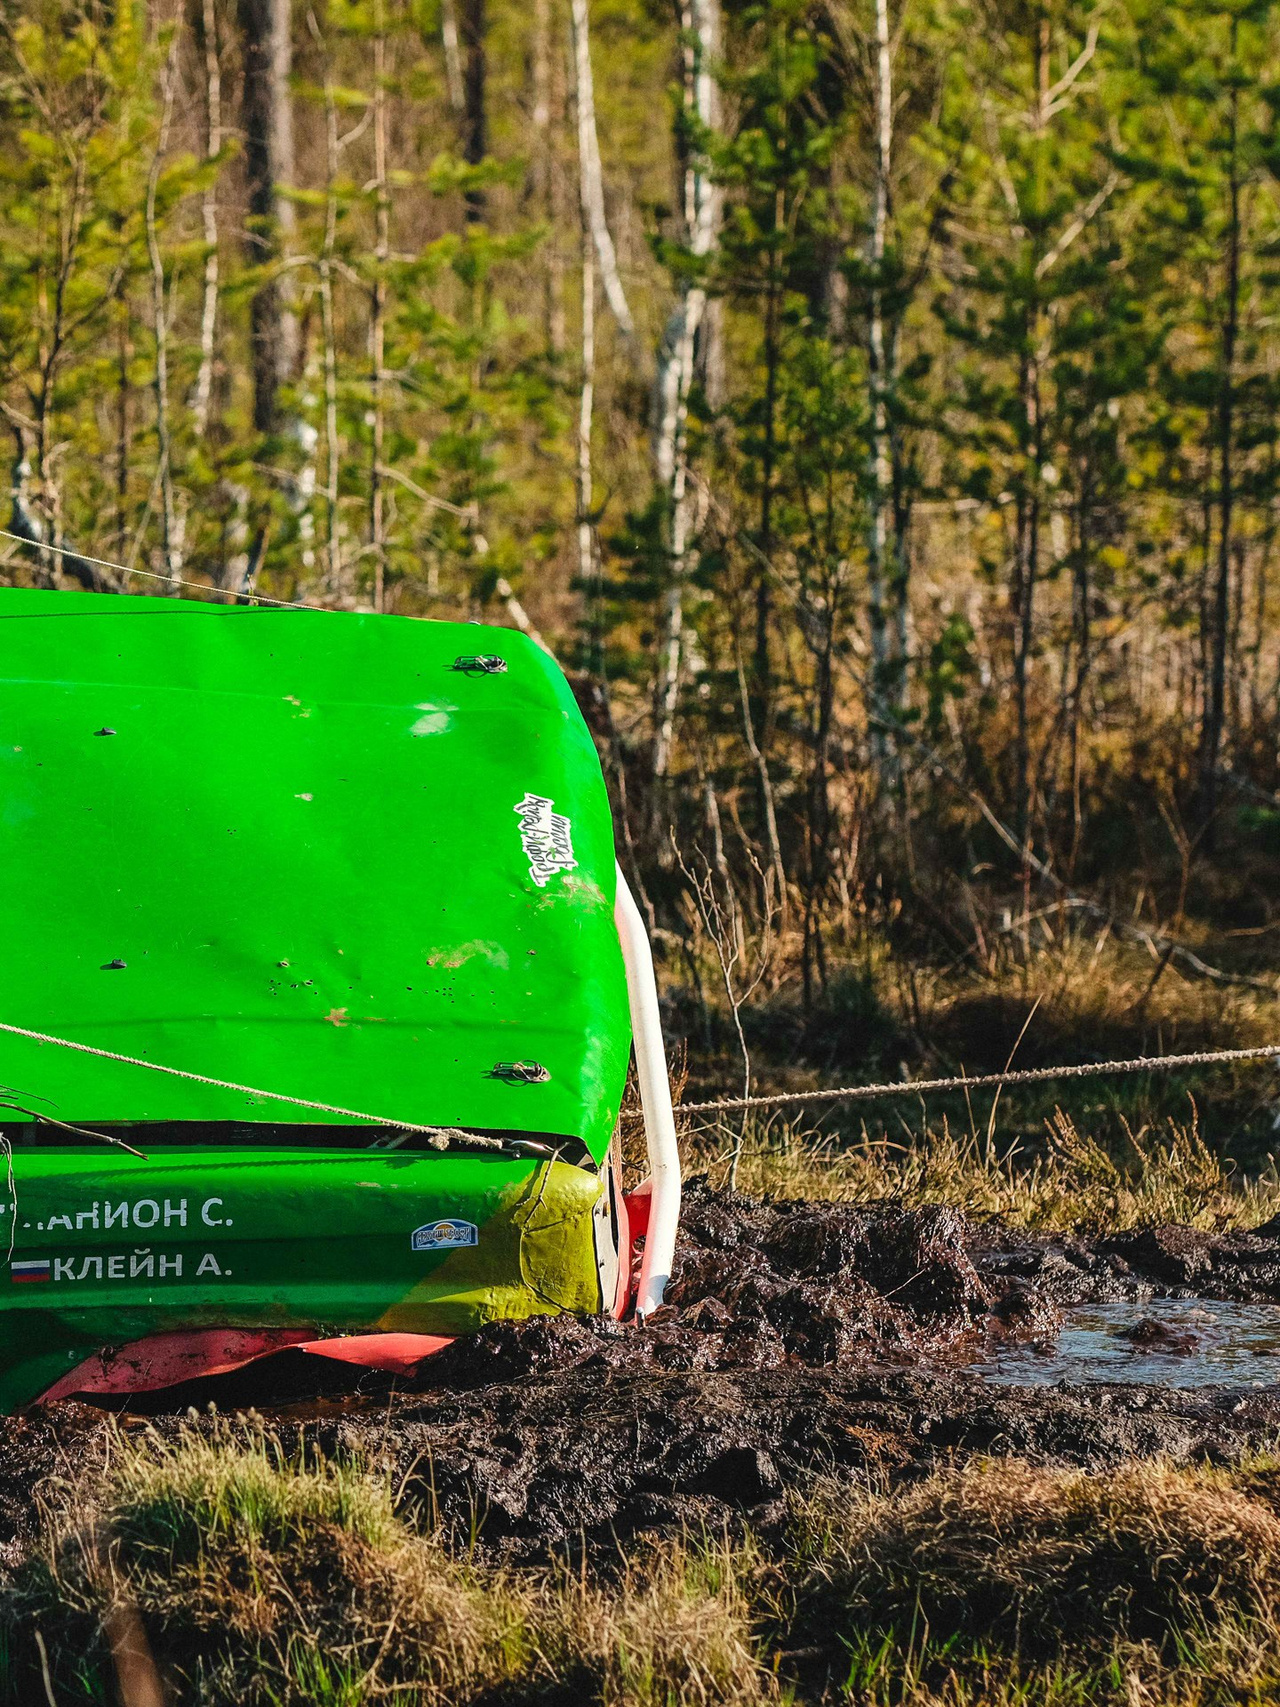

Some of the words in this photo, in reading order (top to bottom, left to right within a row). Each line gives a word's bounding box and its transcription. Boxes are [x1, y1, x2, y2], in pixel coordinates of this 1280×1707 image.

[10, 1199, 187, 1231] АНИОН
[54, 1248, 183, 1281] КЛЕЙН
[196, 1253, 233, 1277] А.
